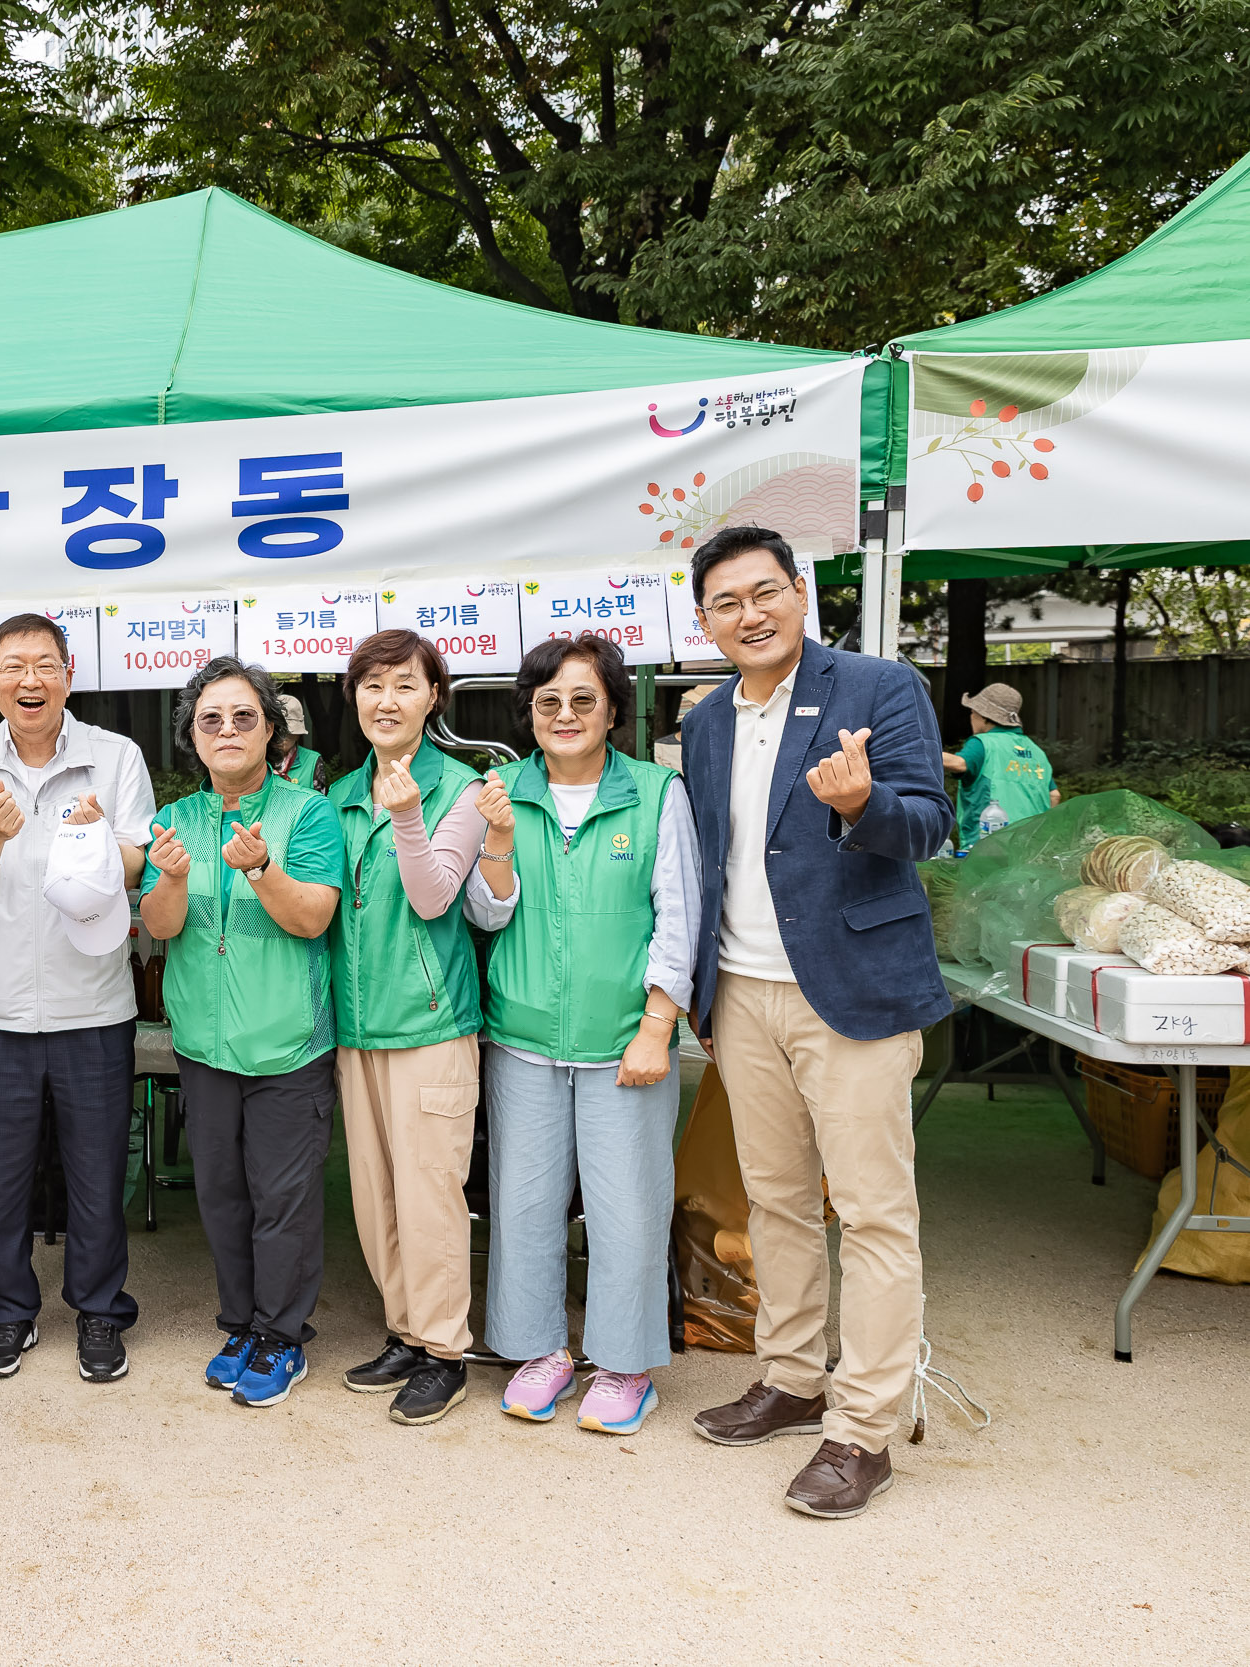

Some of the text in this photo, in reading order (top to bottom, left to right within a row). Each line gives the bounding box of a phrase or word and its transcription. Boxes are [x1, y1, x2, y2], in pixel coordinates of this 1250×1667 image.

[715, 387, 798, 410] 소통하며 발전하는
[714, 398, 797, 429] 행복광진
[416, 604, 479, 628] 참기름
[550, 594, 636, 618] 모시송편
[127, 619, 205, 641] 지리멸치
[275, 610, 337, 630] 들기름
[262, 637, 353, 657] 13,000원
[435, 634, 497, 656] 000원
[124, 649, 211, 672] 10,000원
[610, 853, 634, 861] SMU
